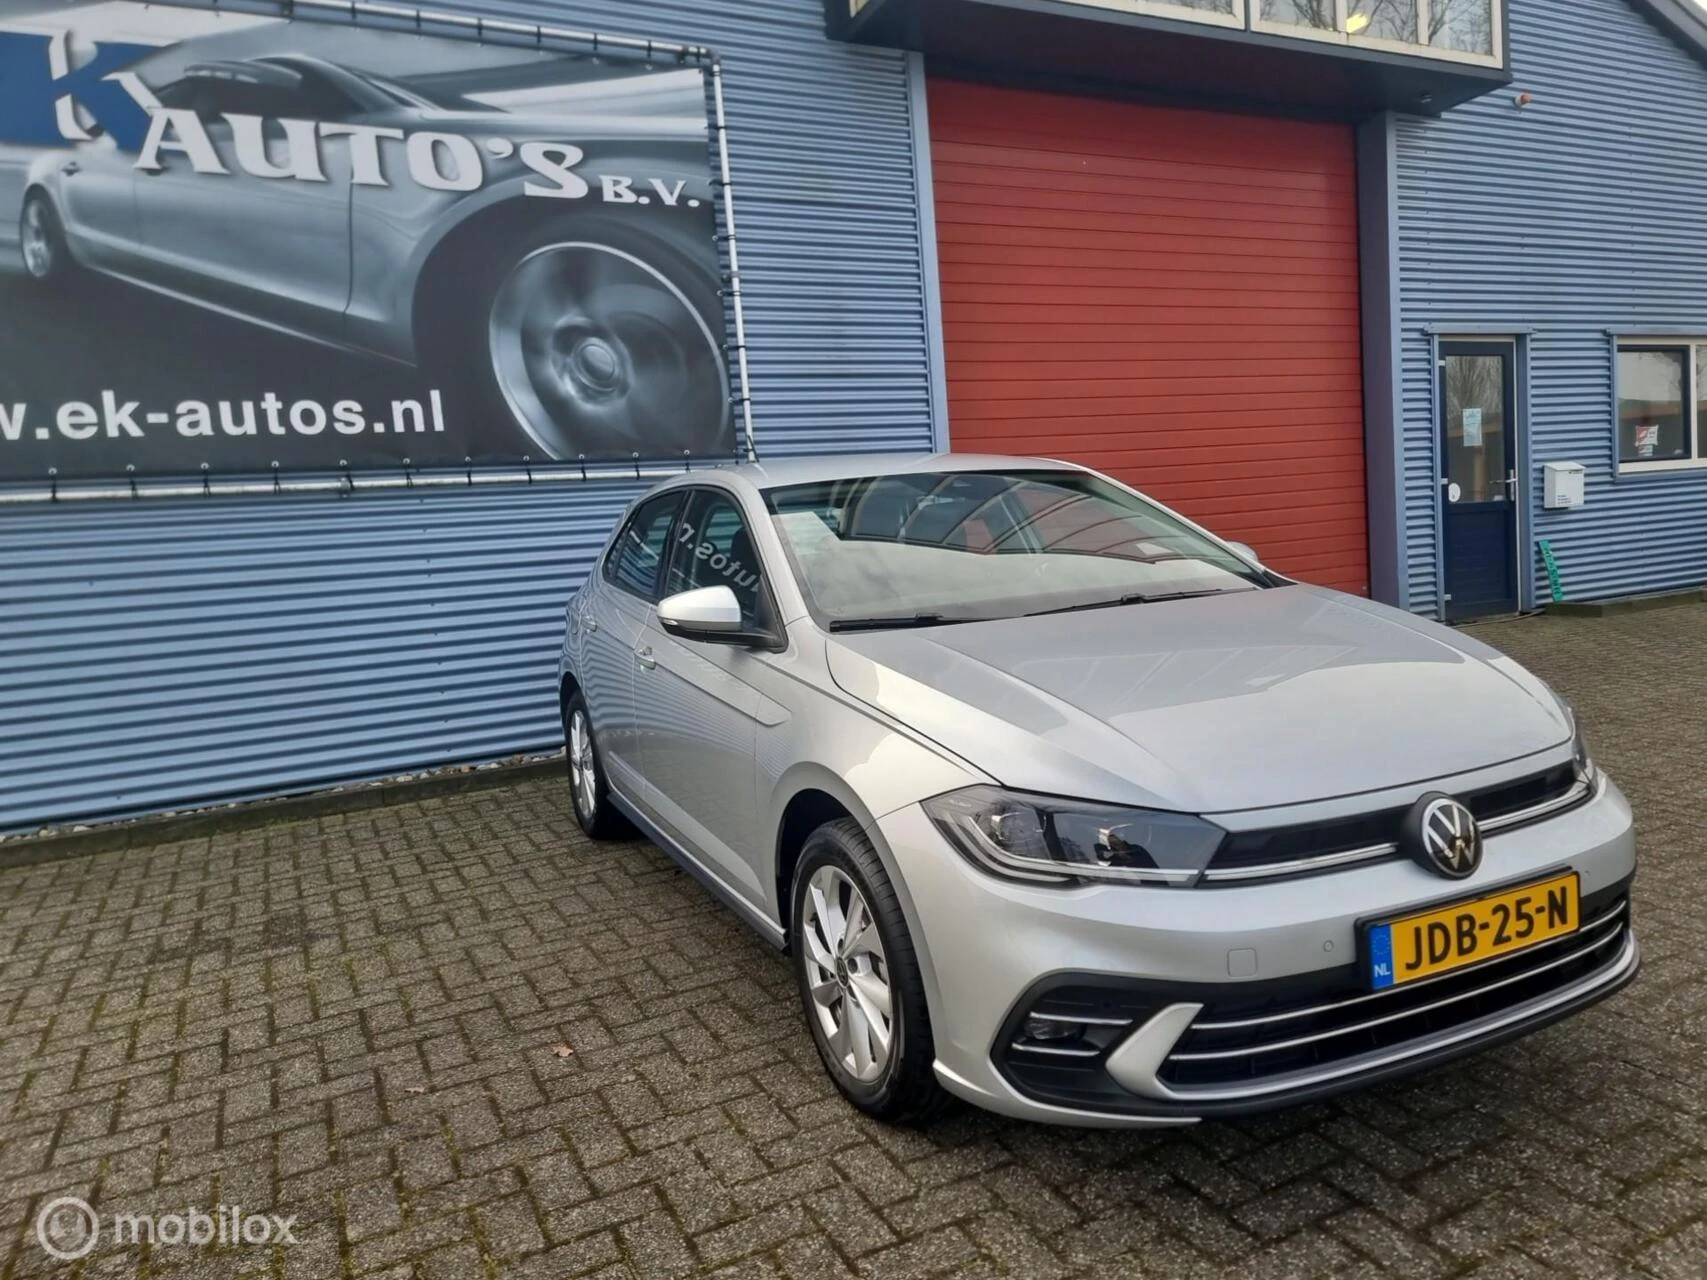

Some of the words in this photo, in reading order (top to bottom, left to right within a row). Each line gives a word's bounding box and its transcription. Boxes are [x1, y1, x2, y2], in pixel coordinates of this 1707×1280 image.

[599, 173, 701, 208] B.V.
[1373, 961, 1392, 978] NL
[1404, 885, 1569, 972] JDB-25-N
